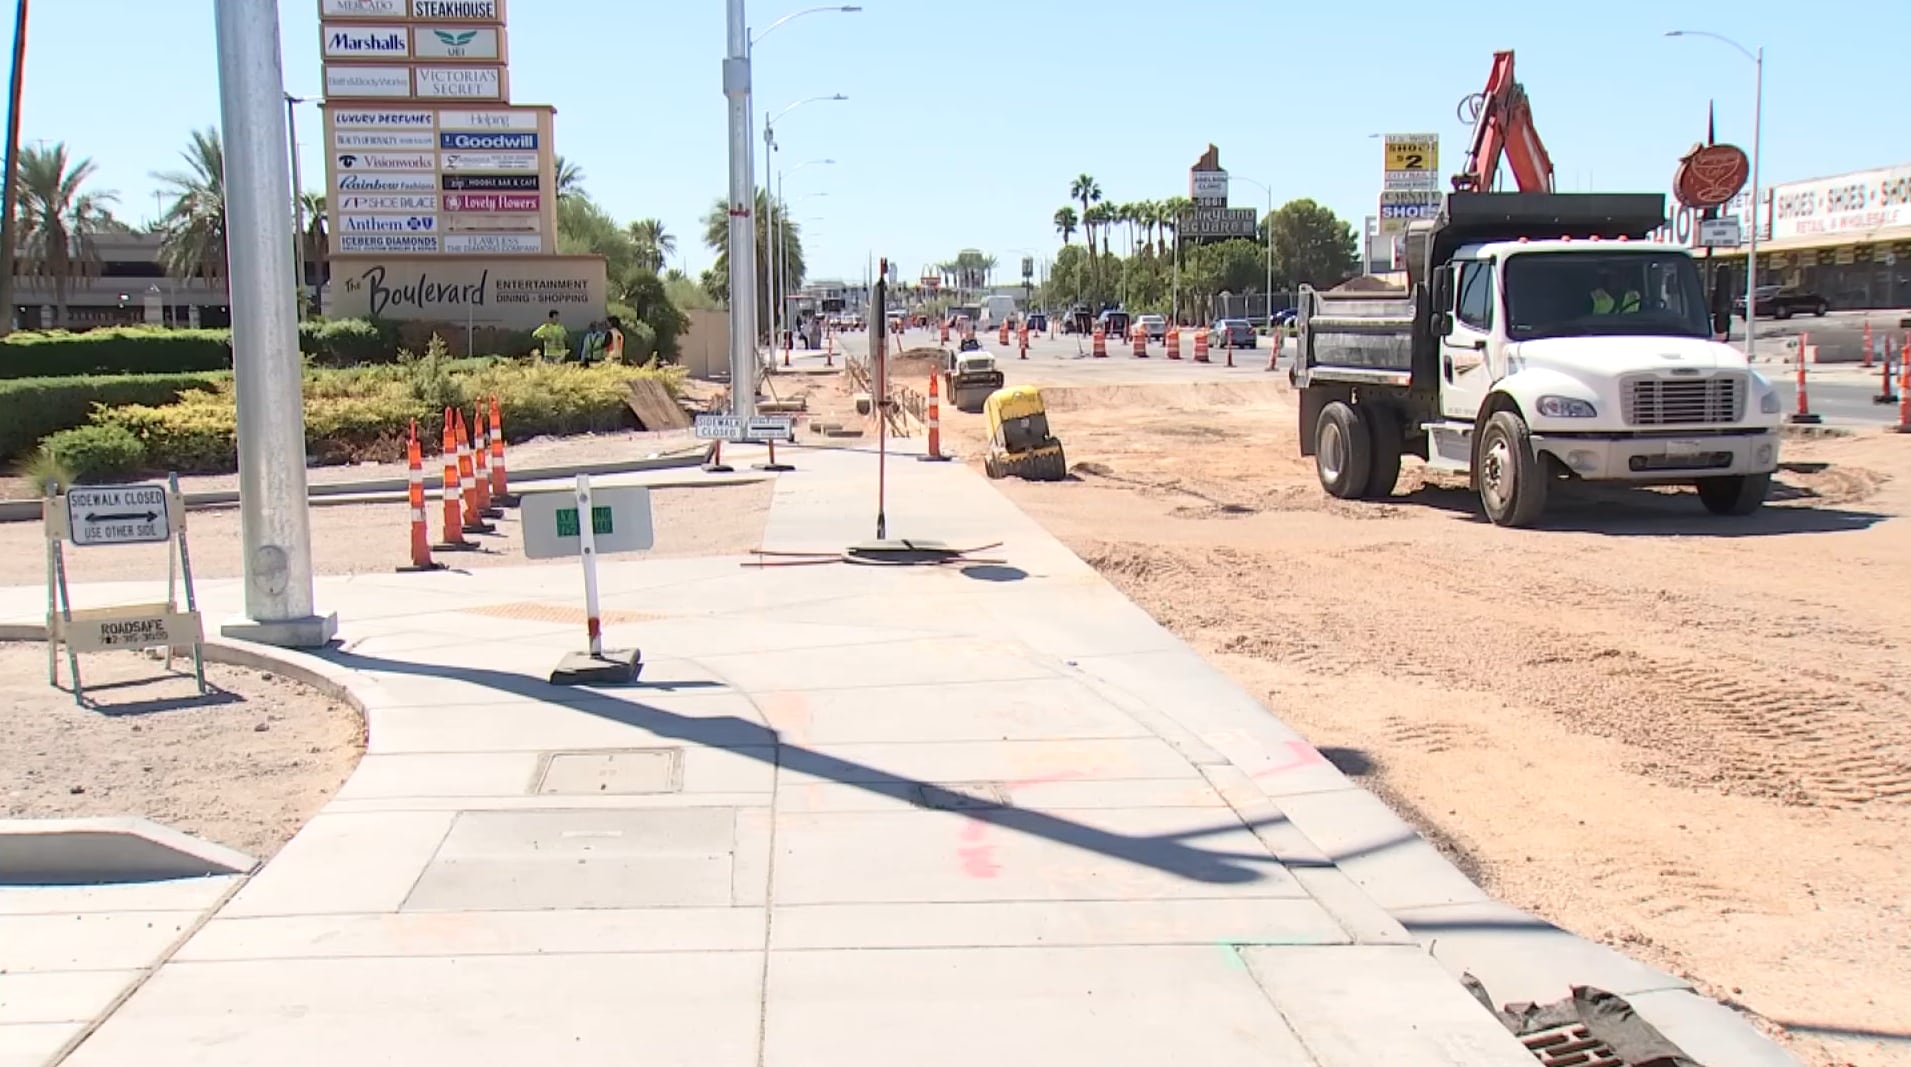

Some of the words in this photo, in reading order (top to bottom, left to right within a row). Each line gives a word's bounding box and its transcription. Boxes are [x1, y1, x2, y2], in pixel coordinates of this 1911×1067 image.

[416, 2, 493, 17] STEAKHOUSE
[328, 33, 405, 50] Marshalls
[420, 70, 496, 82] VICTORIA'S
[433, 83, 482, 95] SECRET
[337, 114, 375, 124] LUXURY
[378, 114, 432, 124] PERFUMES
[455, 135, 533, 148] Goodwill
[364, 155, 432, 168] Visionworks
[340, 175, 398, 190] Rainbow
[464, 195, 496, 212] Lovely
[1778, 192, 1815, 219] SHOES
[1827, 184, 1865, 213] SHOES
[1881, 177, 1911, 206] SHO
[1382, 206, 1438, 217] SHOES
[346, 217, 402, 230] Anthem
[342, 237, 383, 246] ICEBERG
[386, 237, 437, 246] DIAMONDS
[345, 277, 361, 293] The
[362, 265, 488, 316] Boulevard
[496, 279, 588, 290] ENTERTAINMENT
[496, 293, 529, 303] DINING
[538, 293, 588, 304] SHOPPING
[71, 494, 121, 507] SIDEWALK
[126, 491, 162, 505] CLOSED
[84, 529, 102, 539] USE
[105, 526, 134, 538] OTHER
[137, 524, 157, 537] SIDE
[101, 619, 164, 634] ROADSAFE
